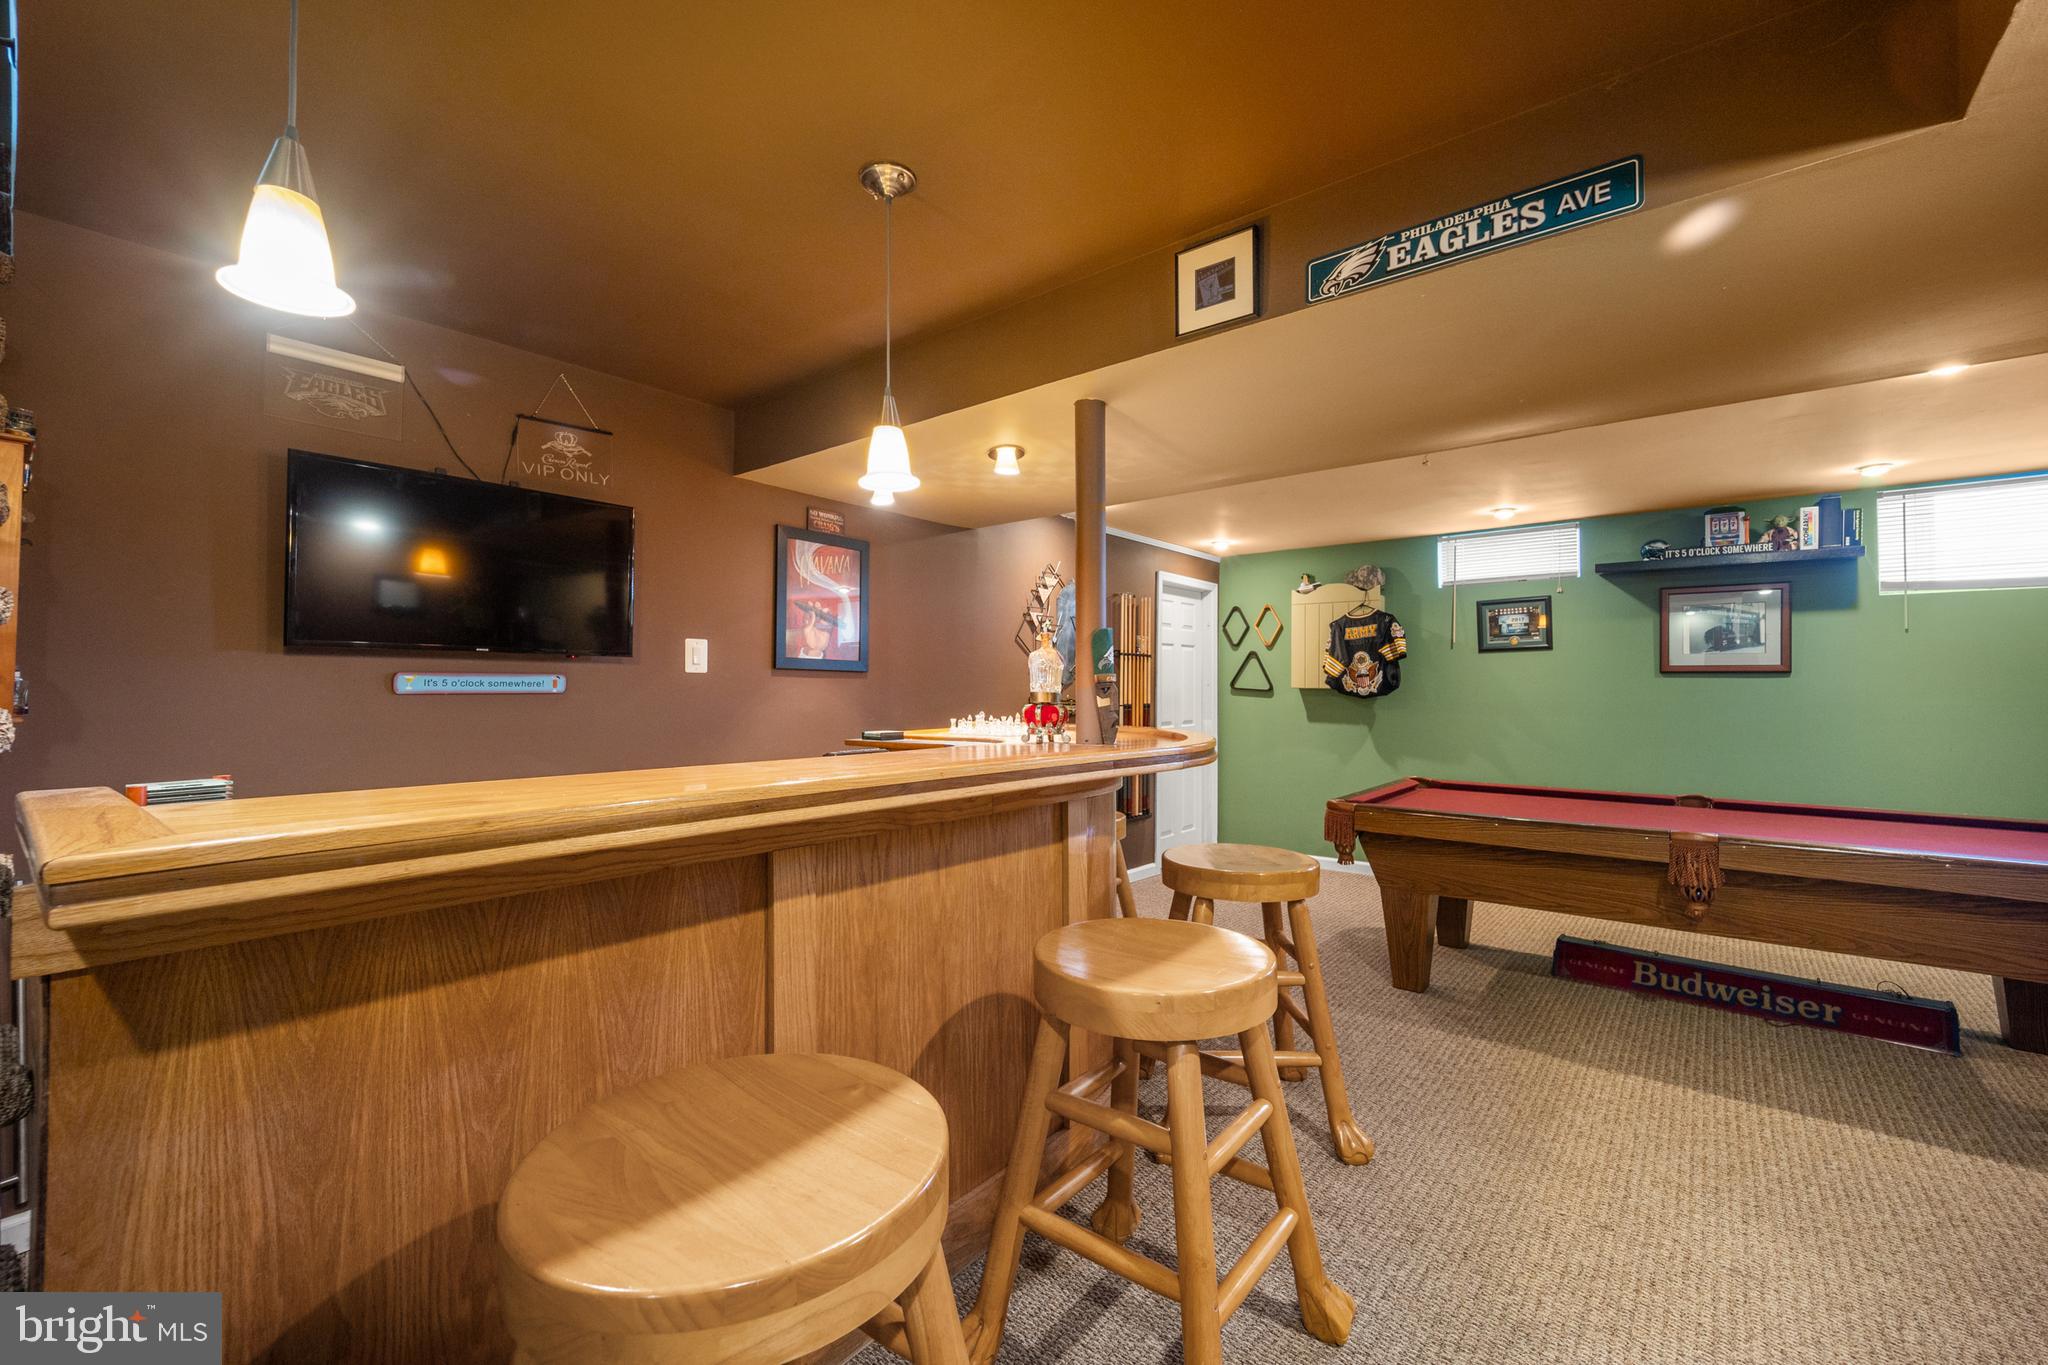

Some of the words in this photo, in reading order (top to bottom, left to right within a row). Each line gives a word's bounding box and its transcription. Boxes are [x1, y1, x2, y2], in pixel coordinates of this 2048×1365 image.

[1386, 199, 1547, 271] EAGLES
[1557, 180, 1612, 216] AVE
[1400, 198, 1512, 242] PHILADELPHIA
[522, 461, 555, 477] VIP
[560, 468, 610, 486] ONLY
[1665, 549, 1680, 558] IT'S
[1681, 548, 1687, 557] 5
[1688, 547, 1721, 557] O'CLOCK
[1722, 542, 1774, 554] SOMEWHERE
[1344, 624, 1378, 640] ARMY
[423, 678, 438, 687] It's
[441, 678, 448, 687] 5
[451, 679, 485, 688] o'clock
[487, 680, 545, 688] somewhere!
[1632, 960, 1842, 1024] Budweiser
